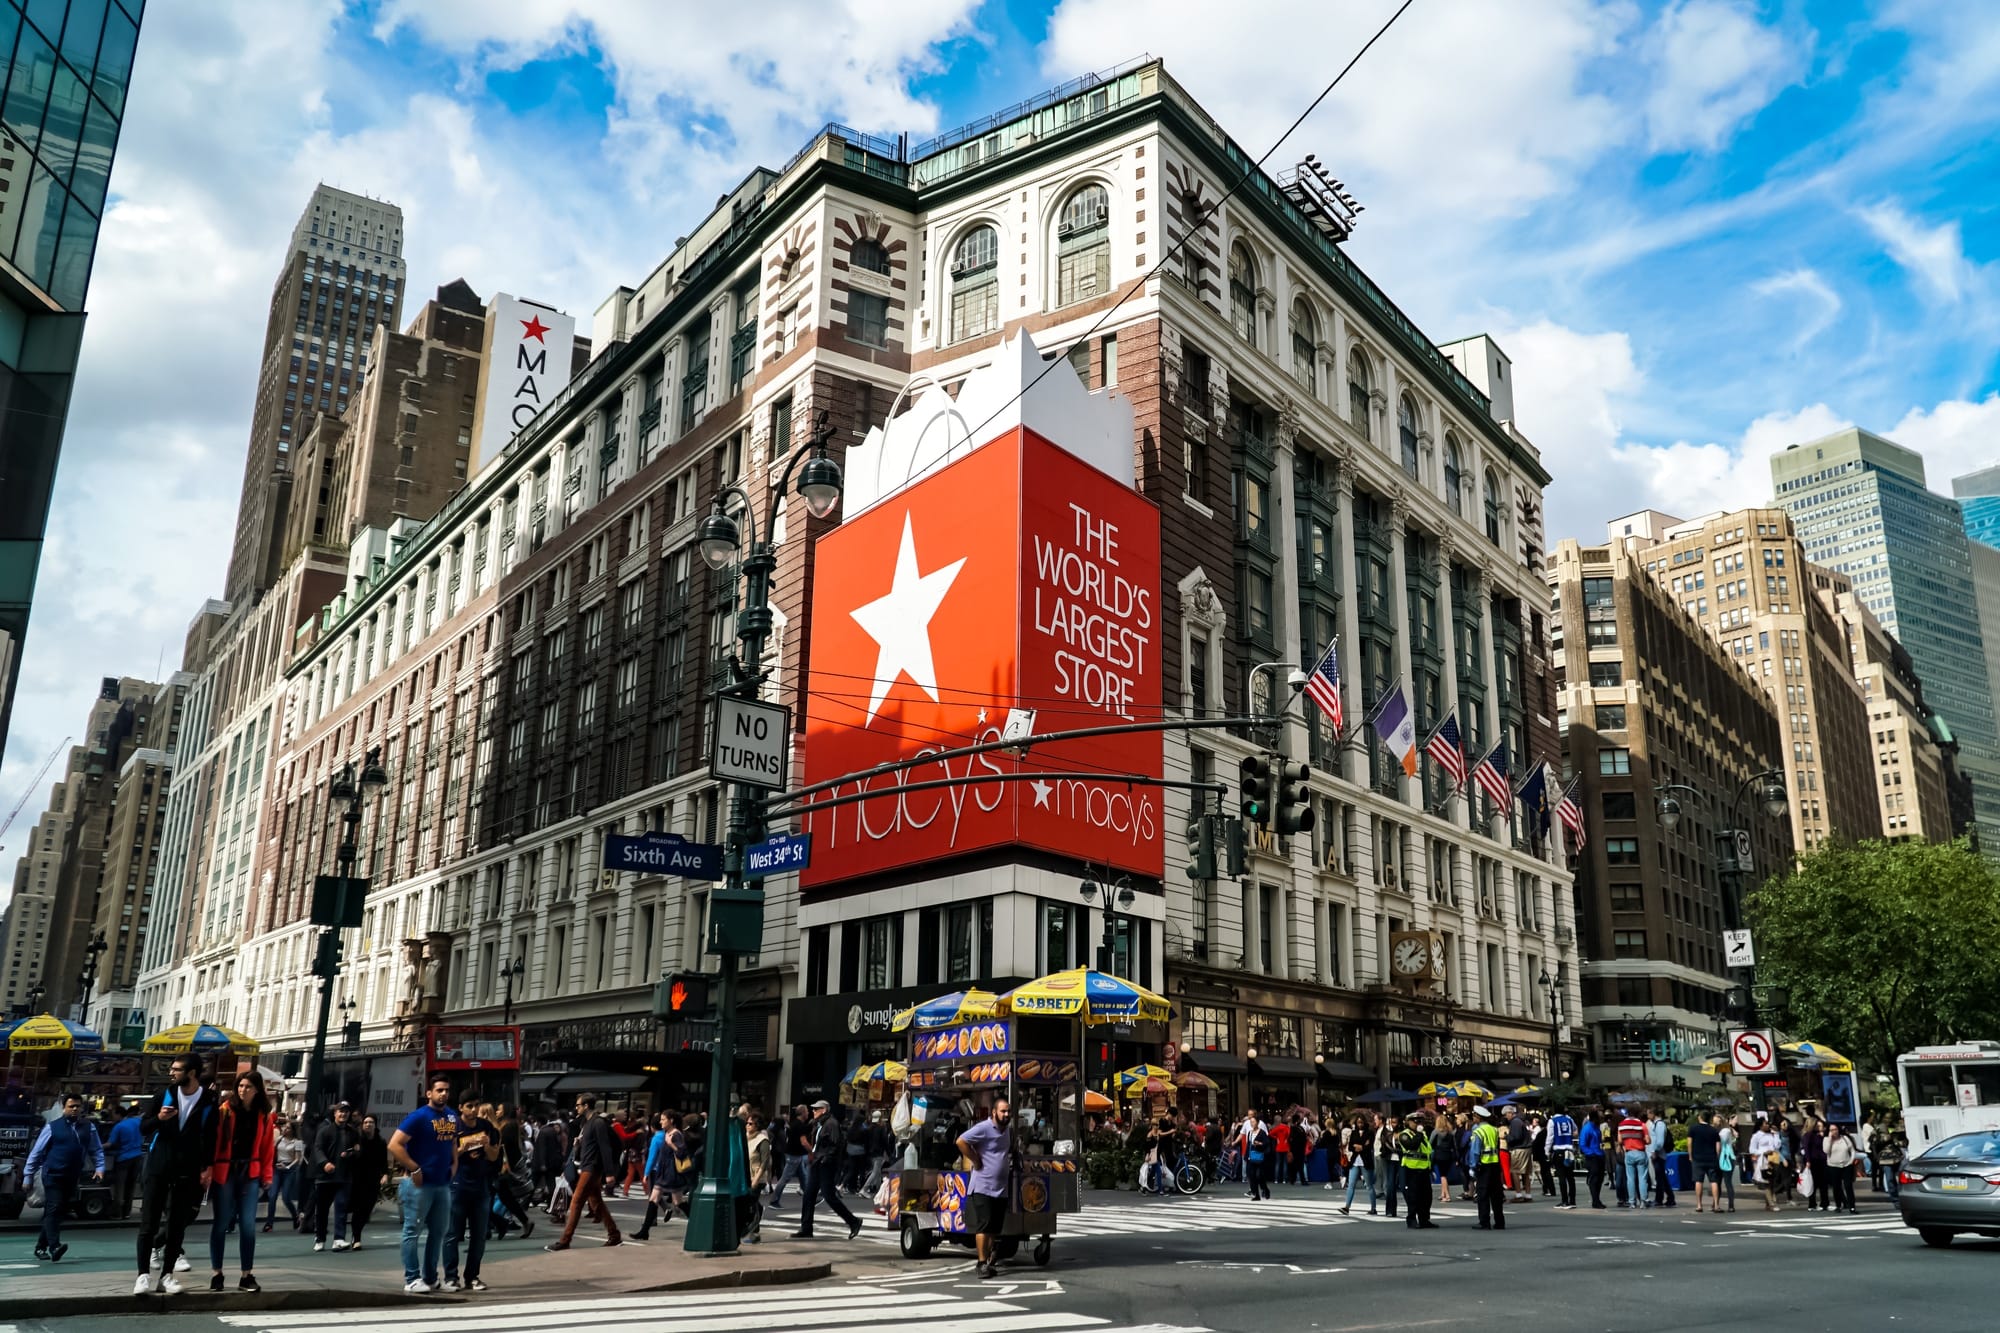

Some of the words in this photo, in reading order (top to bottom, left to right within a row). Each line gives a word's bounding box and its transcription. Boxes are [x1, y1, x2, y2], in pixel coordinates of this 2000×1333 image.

[510, 342, 547, 437] MAC
[1069, 502, 1119, 566] THE
[1034, 535, 1151, 629] WORLD'S
[1035, 586, 1149, 675] LARGEST
[1054, 650, 1136, 722] STORE
[736, 712, 768, 741] NO
[720, 745, 779, 774] TURNS
[649, 837, 680, 845] BROADWAY
[623, 845, 666, 865] Sixth
[670, 850, 702, 869] Ave
[750, 851, 773, 869] West
[774, 844, 791, 865] 34th
[793, 844, 803, 861] St
[1728, 933, 1747, 941] KEEP
[1728, 955, 1751, 963] RIGHT
[1016, 997, 1081, 1010] SABRETT
[129, 1011, 145, 1024] M
[12, 1038, 67, 1047] SABRETT
